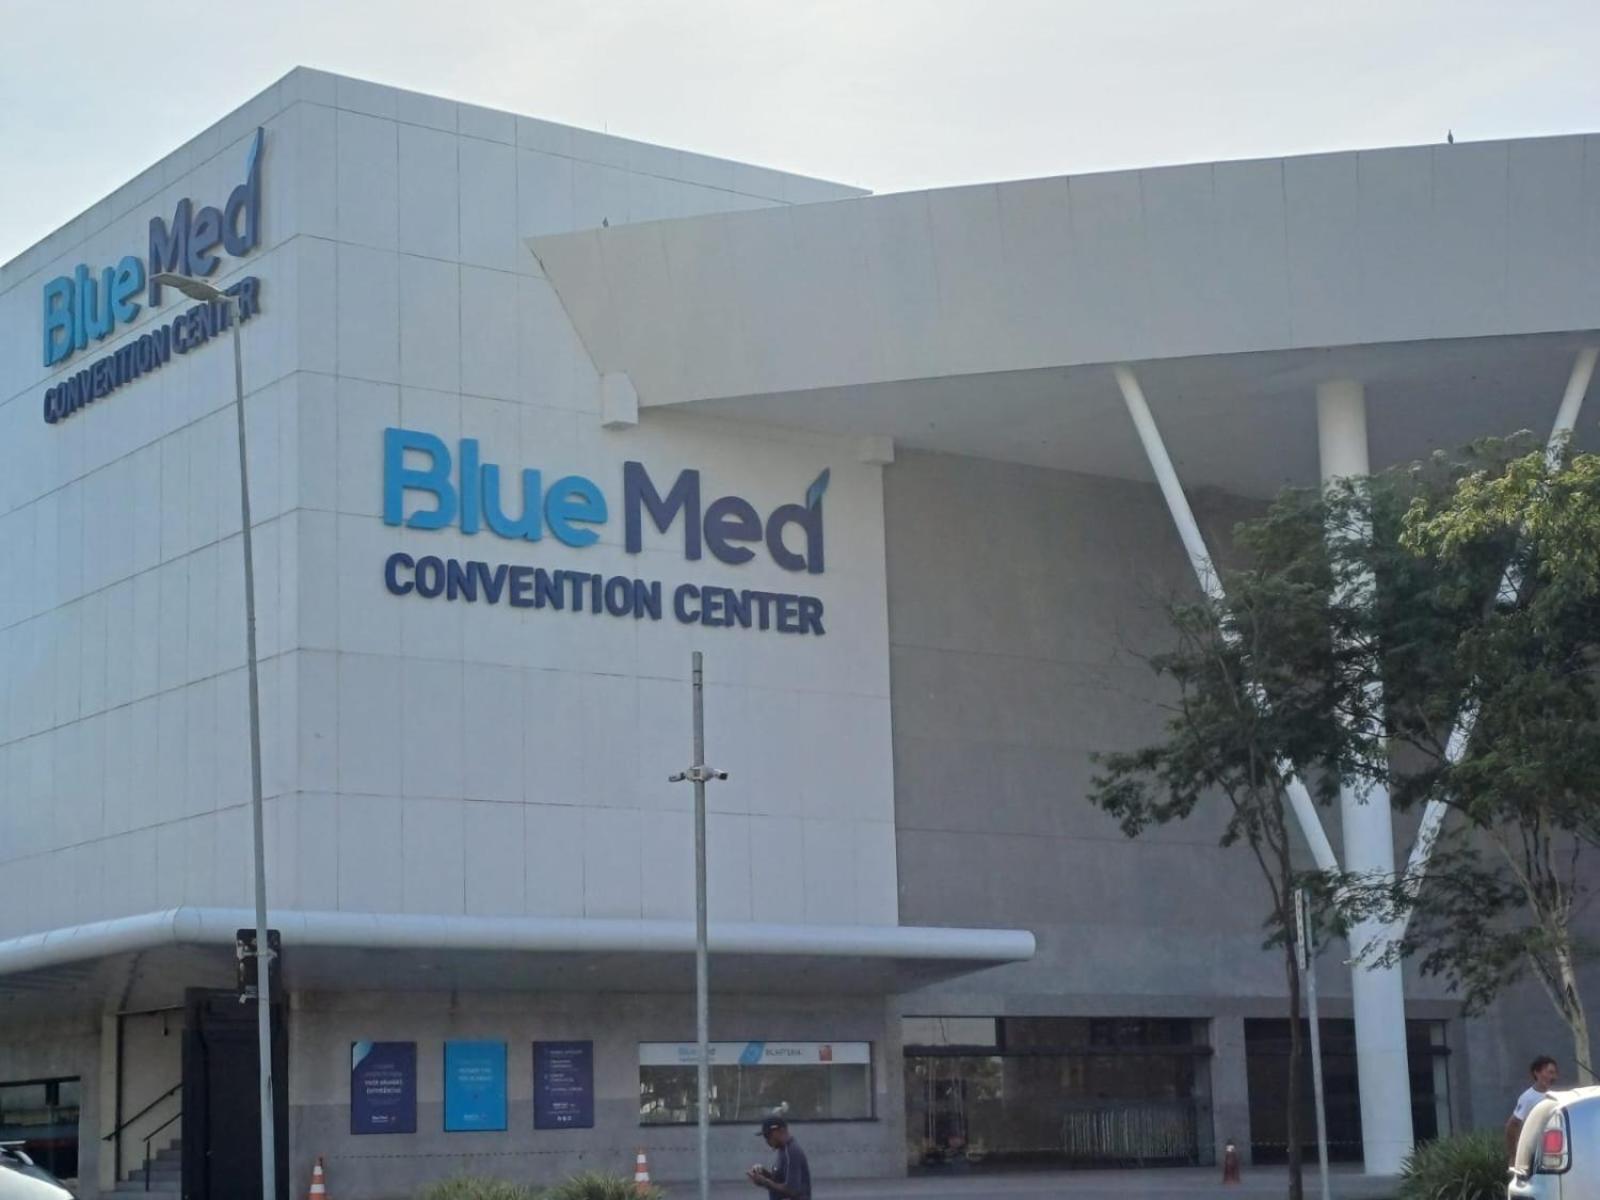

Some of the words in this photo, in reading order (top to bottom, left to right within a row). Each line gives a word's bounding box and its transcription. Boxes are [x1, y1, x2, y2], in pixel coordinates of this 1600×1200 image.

[43, 255, 146, 367] Blue
[149, 126, 264, 308] Med
[44, 324, 171, 424] CONVENTION
[384, 427, 608, 548] Blue
[623, 461, 830, 574] Med
[385, 552, 662, 620] CONVENTION
[674, 583, 826, 636] CENTER
